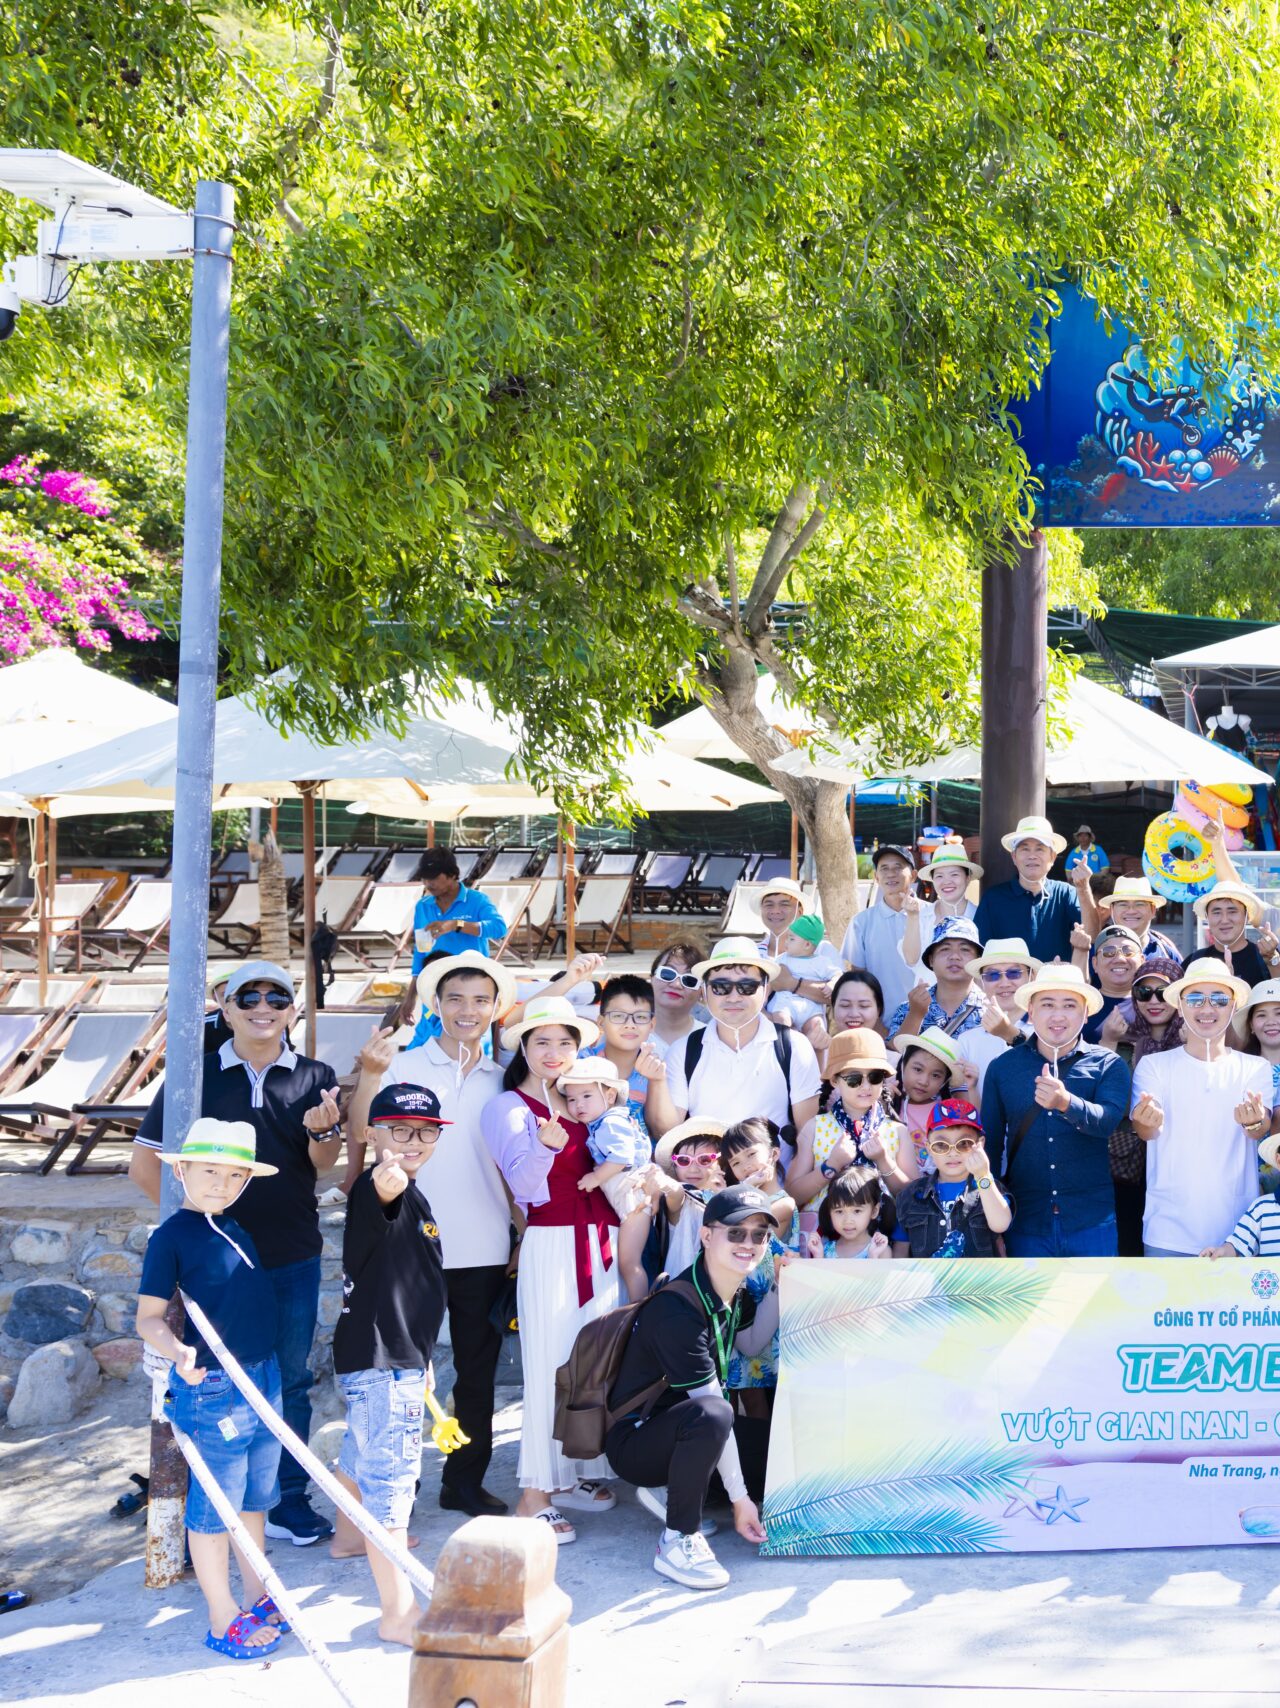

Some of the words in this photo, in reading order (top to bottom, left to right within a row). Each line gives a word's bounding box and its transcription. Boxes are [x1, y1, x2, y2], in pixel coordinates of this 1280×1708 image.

[395, 1093, 432, 1105] BROOKLYN
[1153, 1307, 1194, 1327] CÔNG
[1198, 1311, 1215, 1327] TY
[1219, 1305, 1239, 1327] CỔ
[1001, 1407, 1091, 1449] VƯỢT
[1096, 1411, 1174, 1442] GIAN
[1181, 1410, 1248, 1440] NAN
[1188, 1464, 1219, 1478] Nha
[1222, 1463, 1267, 1480] Trang,
